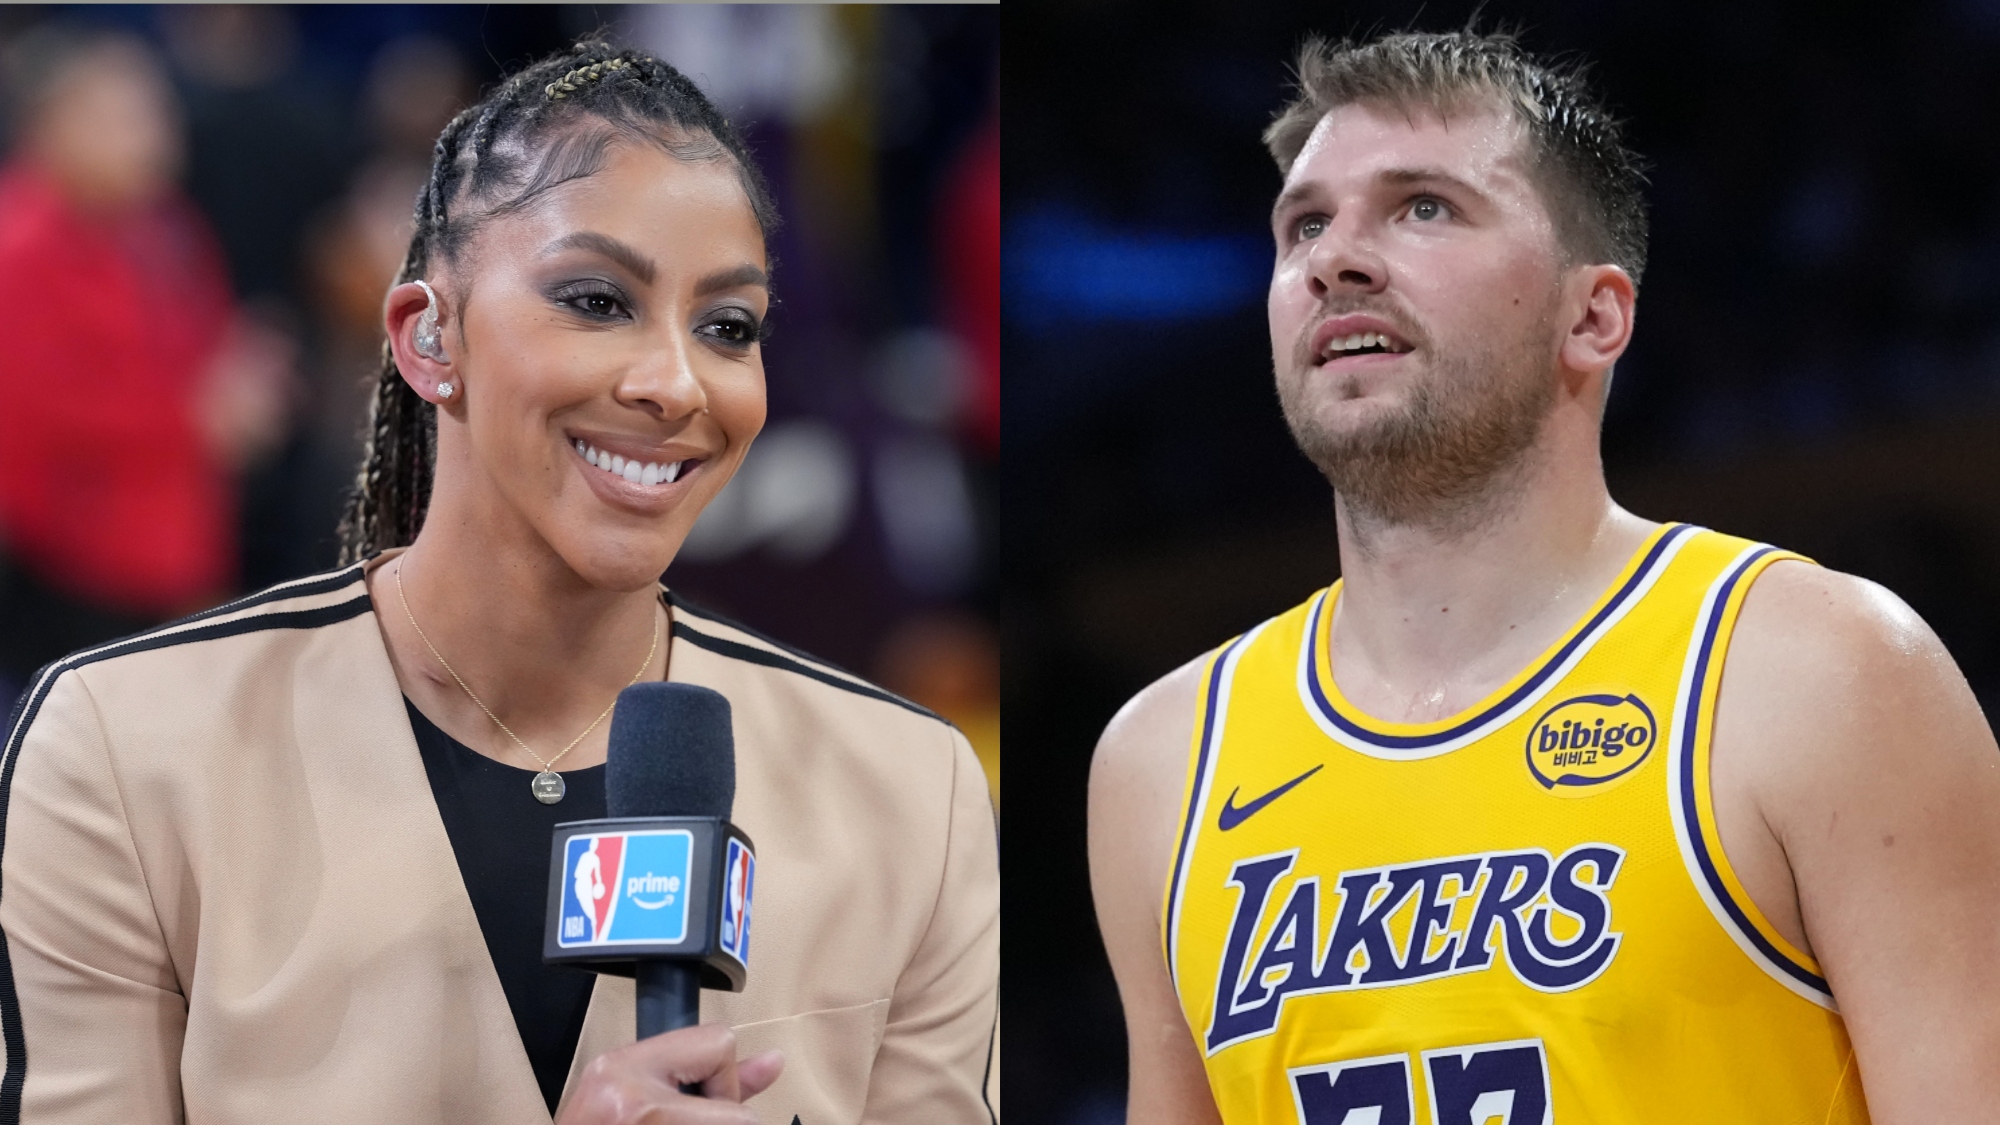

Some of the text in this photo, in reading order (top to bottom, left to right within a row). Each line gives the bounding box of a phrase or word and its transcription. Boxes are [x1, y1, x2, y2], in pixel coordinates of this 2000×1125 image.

[1538, 718, 1648, 757] bibigo
[1553, 750, 1598, 767] 비비고
[627, 872, 681, 898] prime
[564, 915, 584, 938] NBA
[1204, 842, 1627, 1058] LAKERS
